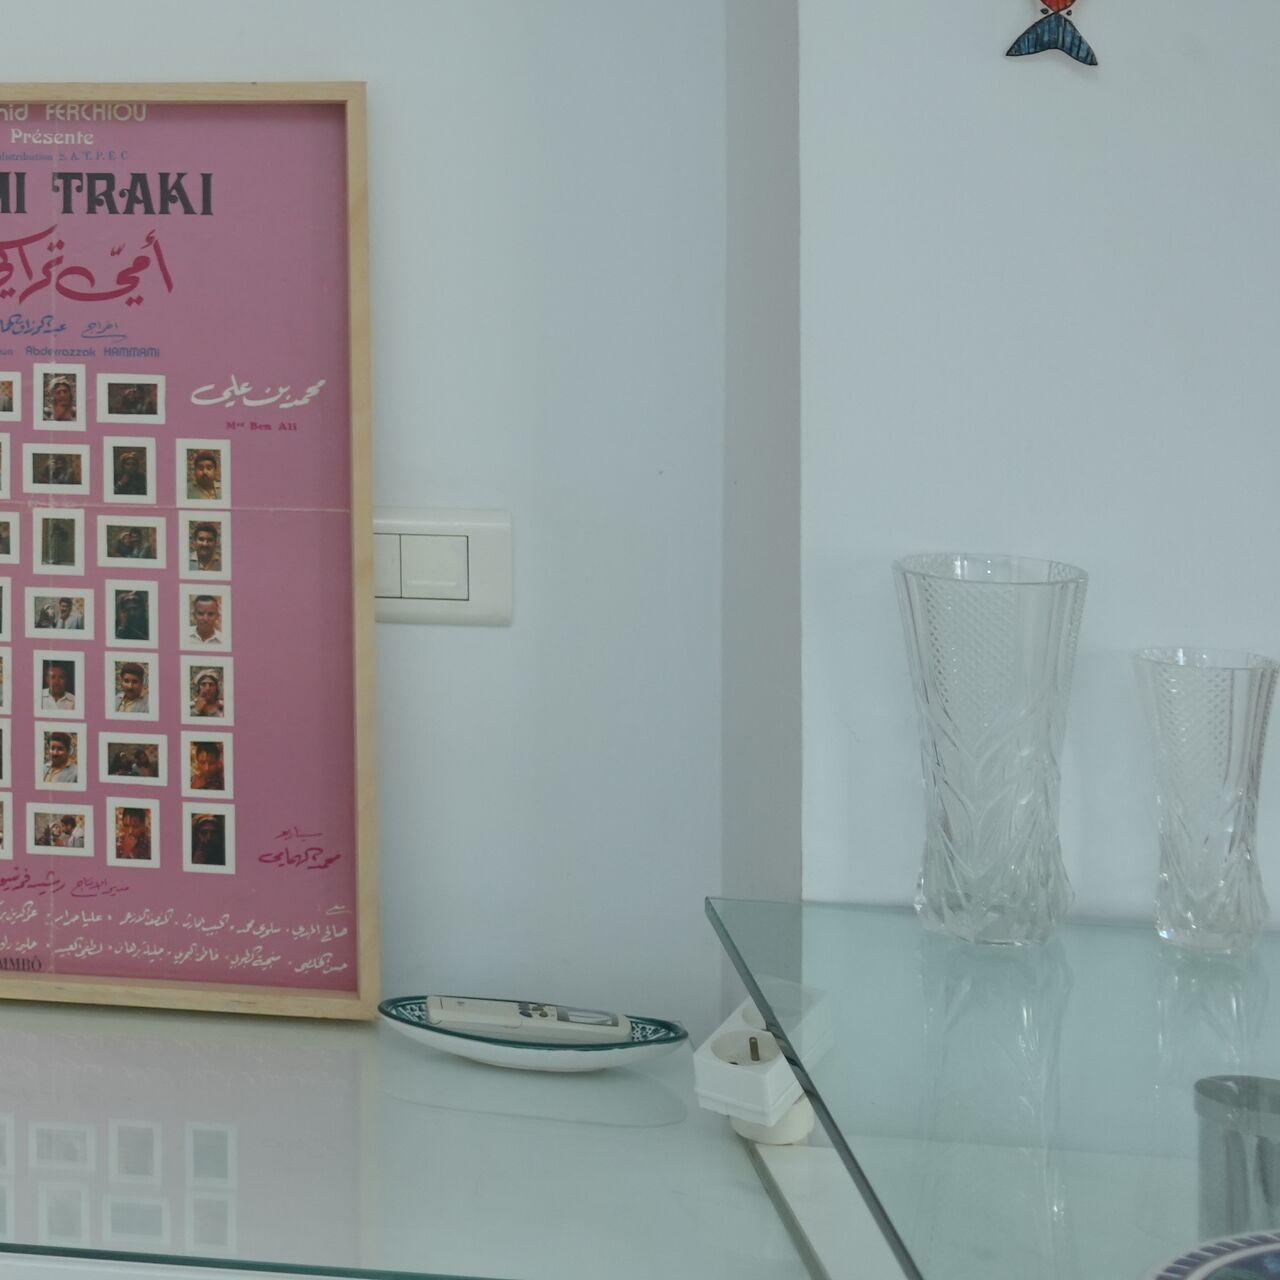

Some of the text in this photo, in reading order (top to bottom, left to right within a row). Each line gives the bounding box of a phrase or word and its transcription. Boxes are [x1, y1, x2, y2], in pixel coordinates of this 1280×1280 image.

[46, 103, 146, 121] FERCHIOU
[10, 128, 94, 145] Présente
[51, 171, 214, 216] TRAKI
[104, 347, 160, 357] HAMMAMI
[279, 379, 327, 408] محمد
[250, 422, 297, 431] Ben Ali
